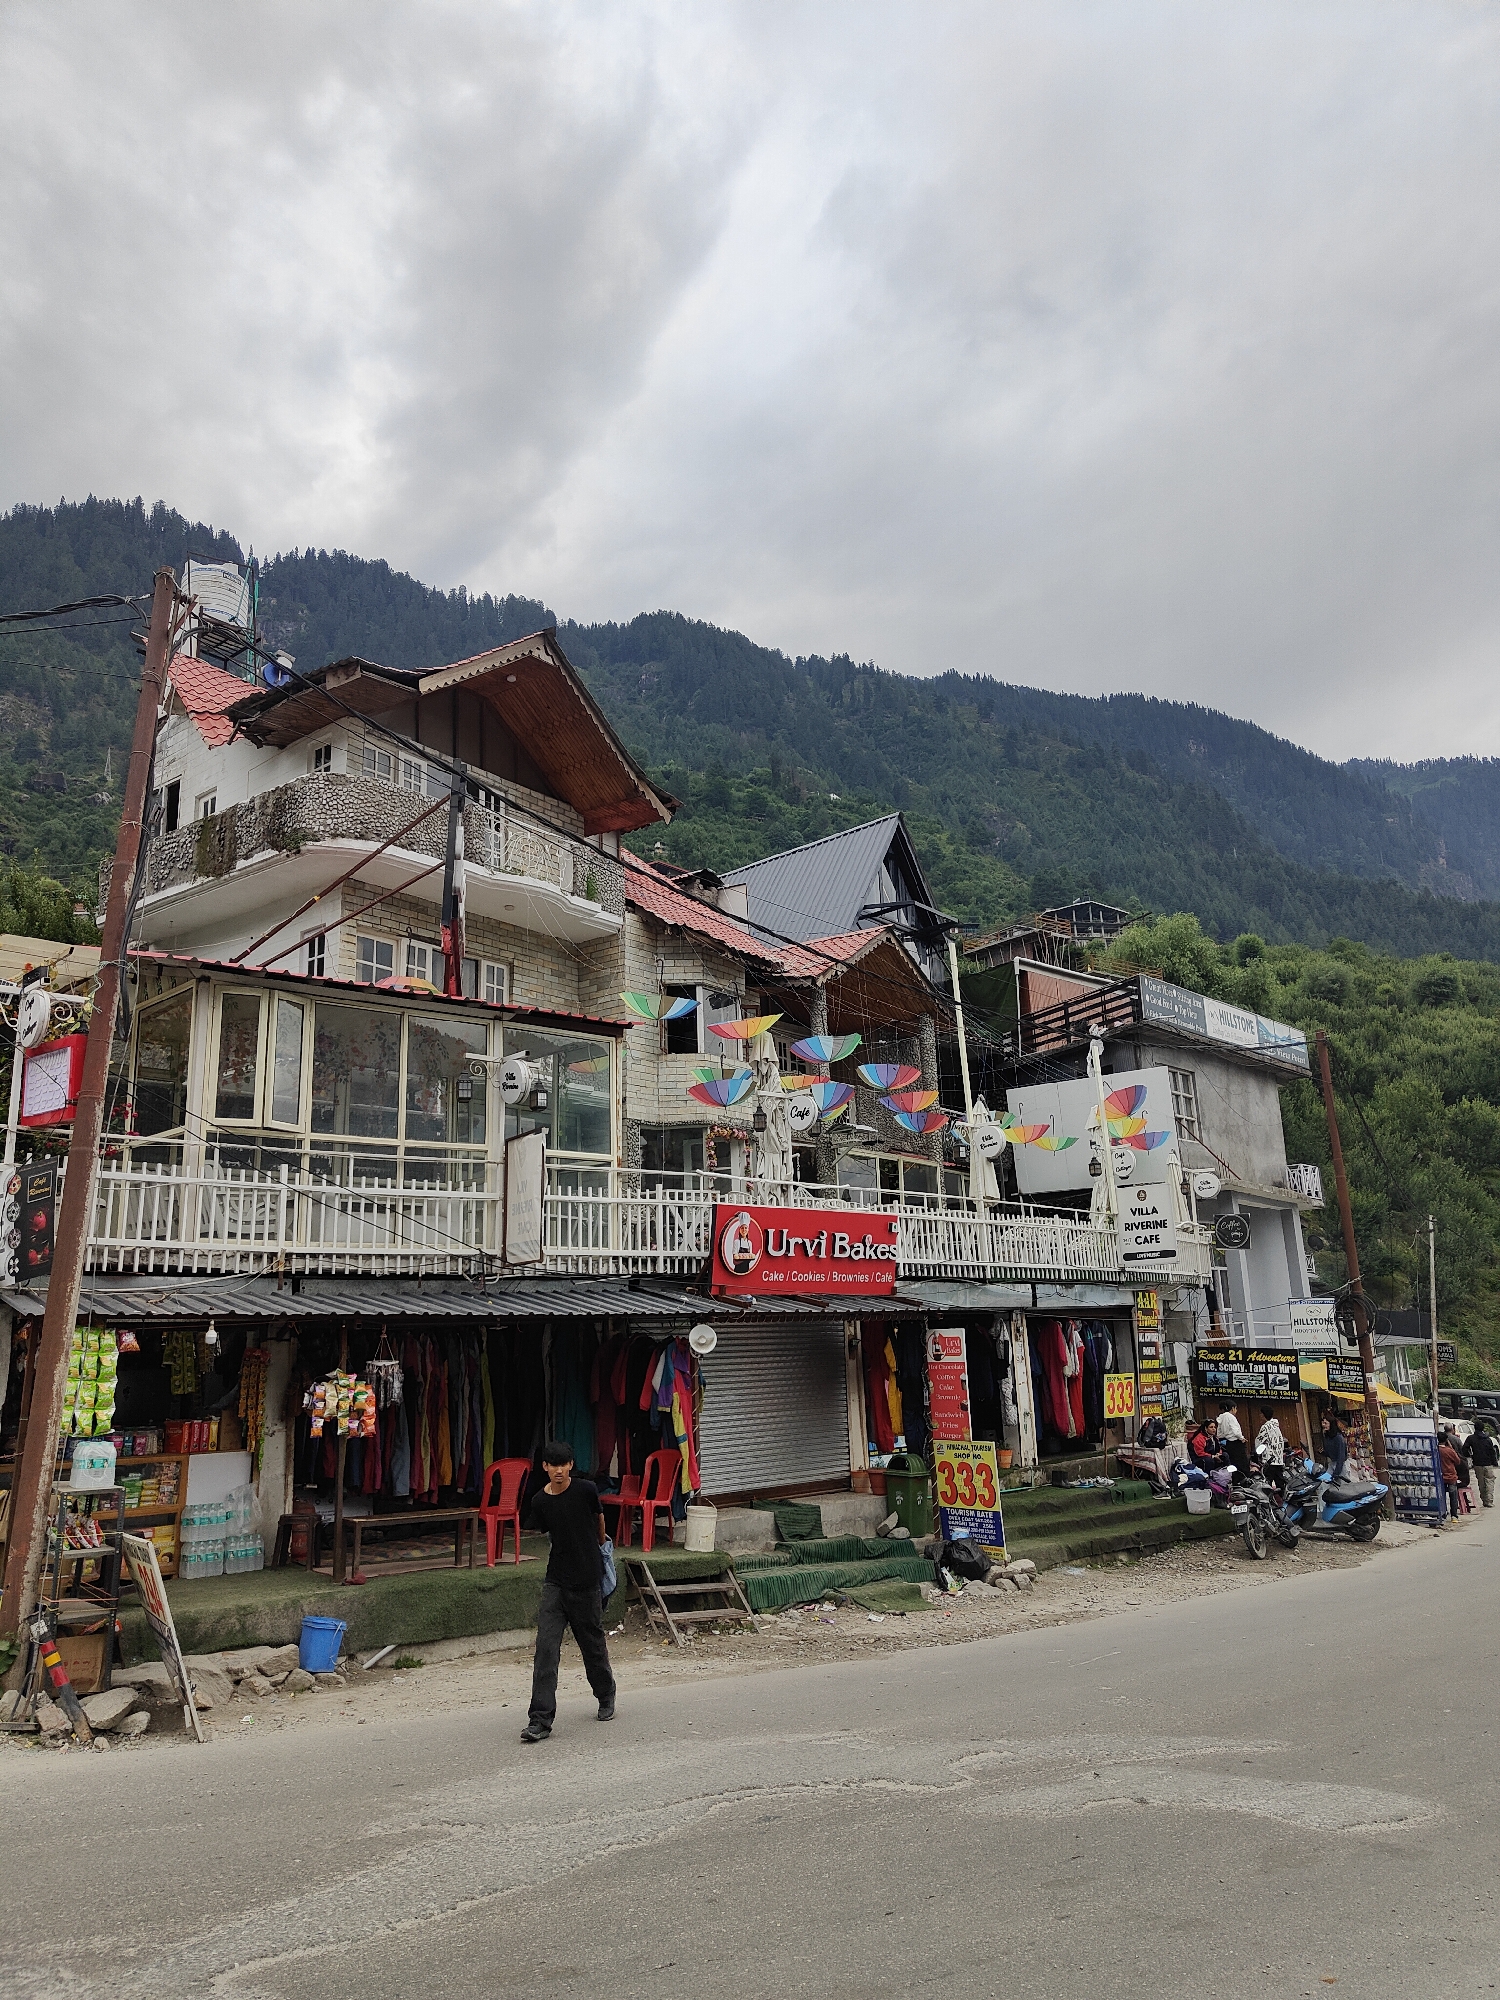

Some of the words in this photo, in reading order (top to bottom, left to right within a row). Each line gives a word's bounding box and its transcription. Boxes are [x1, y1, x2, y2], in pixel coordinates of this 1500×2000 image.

[1218, 1008, 1256, 1036] HILLSTONE
[1276, 1047, 1291, 1060] View
[1291, 1052, 1306, 1065] Point
[790, 1105, 811, 1121] Café
[1129, 1206, 1159, 1216] VILLA
[1124, 1219, 1168, 1231] RIVERINE
[1220, 1219, 1241, 1231] Coffee
[766, 1228, 828, 1259] Urvi
[832, 1232, 897, 1260] Bakes
[1134, 1234, 1161, 1245] CAFE
[762, 1270, 785, 1282] Cake
[791, 1271, 826, 1282] Cookies
[832, 1272, 869, 1283] Brownies
[875, 1272, 893, 1283] Café
[1293, 1317, 1334, 1326] HILLSTONE
[945, 1338, 961, 1347] Urvi
[1198, 1350, 1225, 1360] Route
[1228, 1350, 1243, 1360] 21
[1247, 1351, 1296, 1362] Adventure
[1249, 1363, 1266, 1372] Taxi
[1267, 1364, 1278, 1373] On
[1279, 1364, 1297, 1374] Hire
[939, 1383, 955, 1391] Cake
[1106, 1381, 1134, 1415] 333
[934, 1411, 964, 1419] Sandwich
[940, 1432, 962, 1440] Burger
[970, 1444, 992, 1452] TOURISM
[937, 1460, 997, 1508] 333
[946, 1508, 975, 1517] TOURISM
[976, 1510, 994, 1519] RATE
